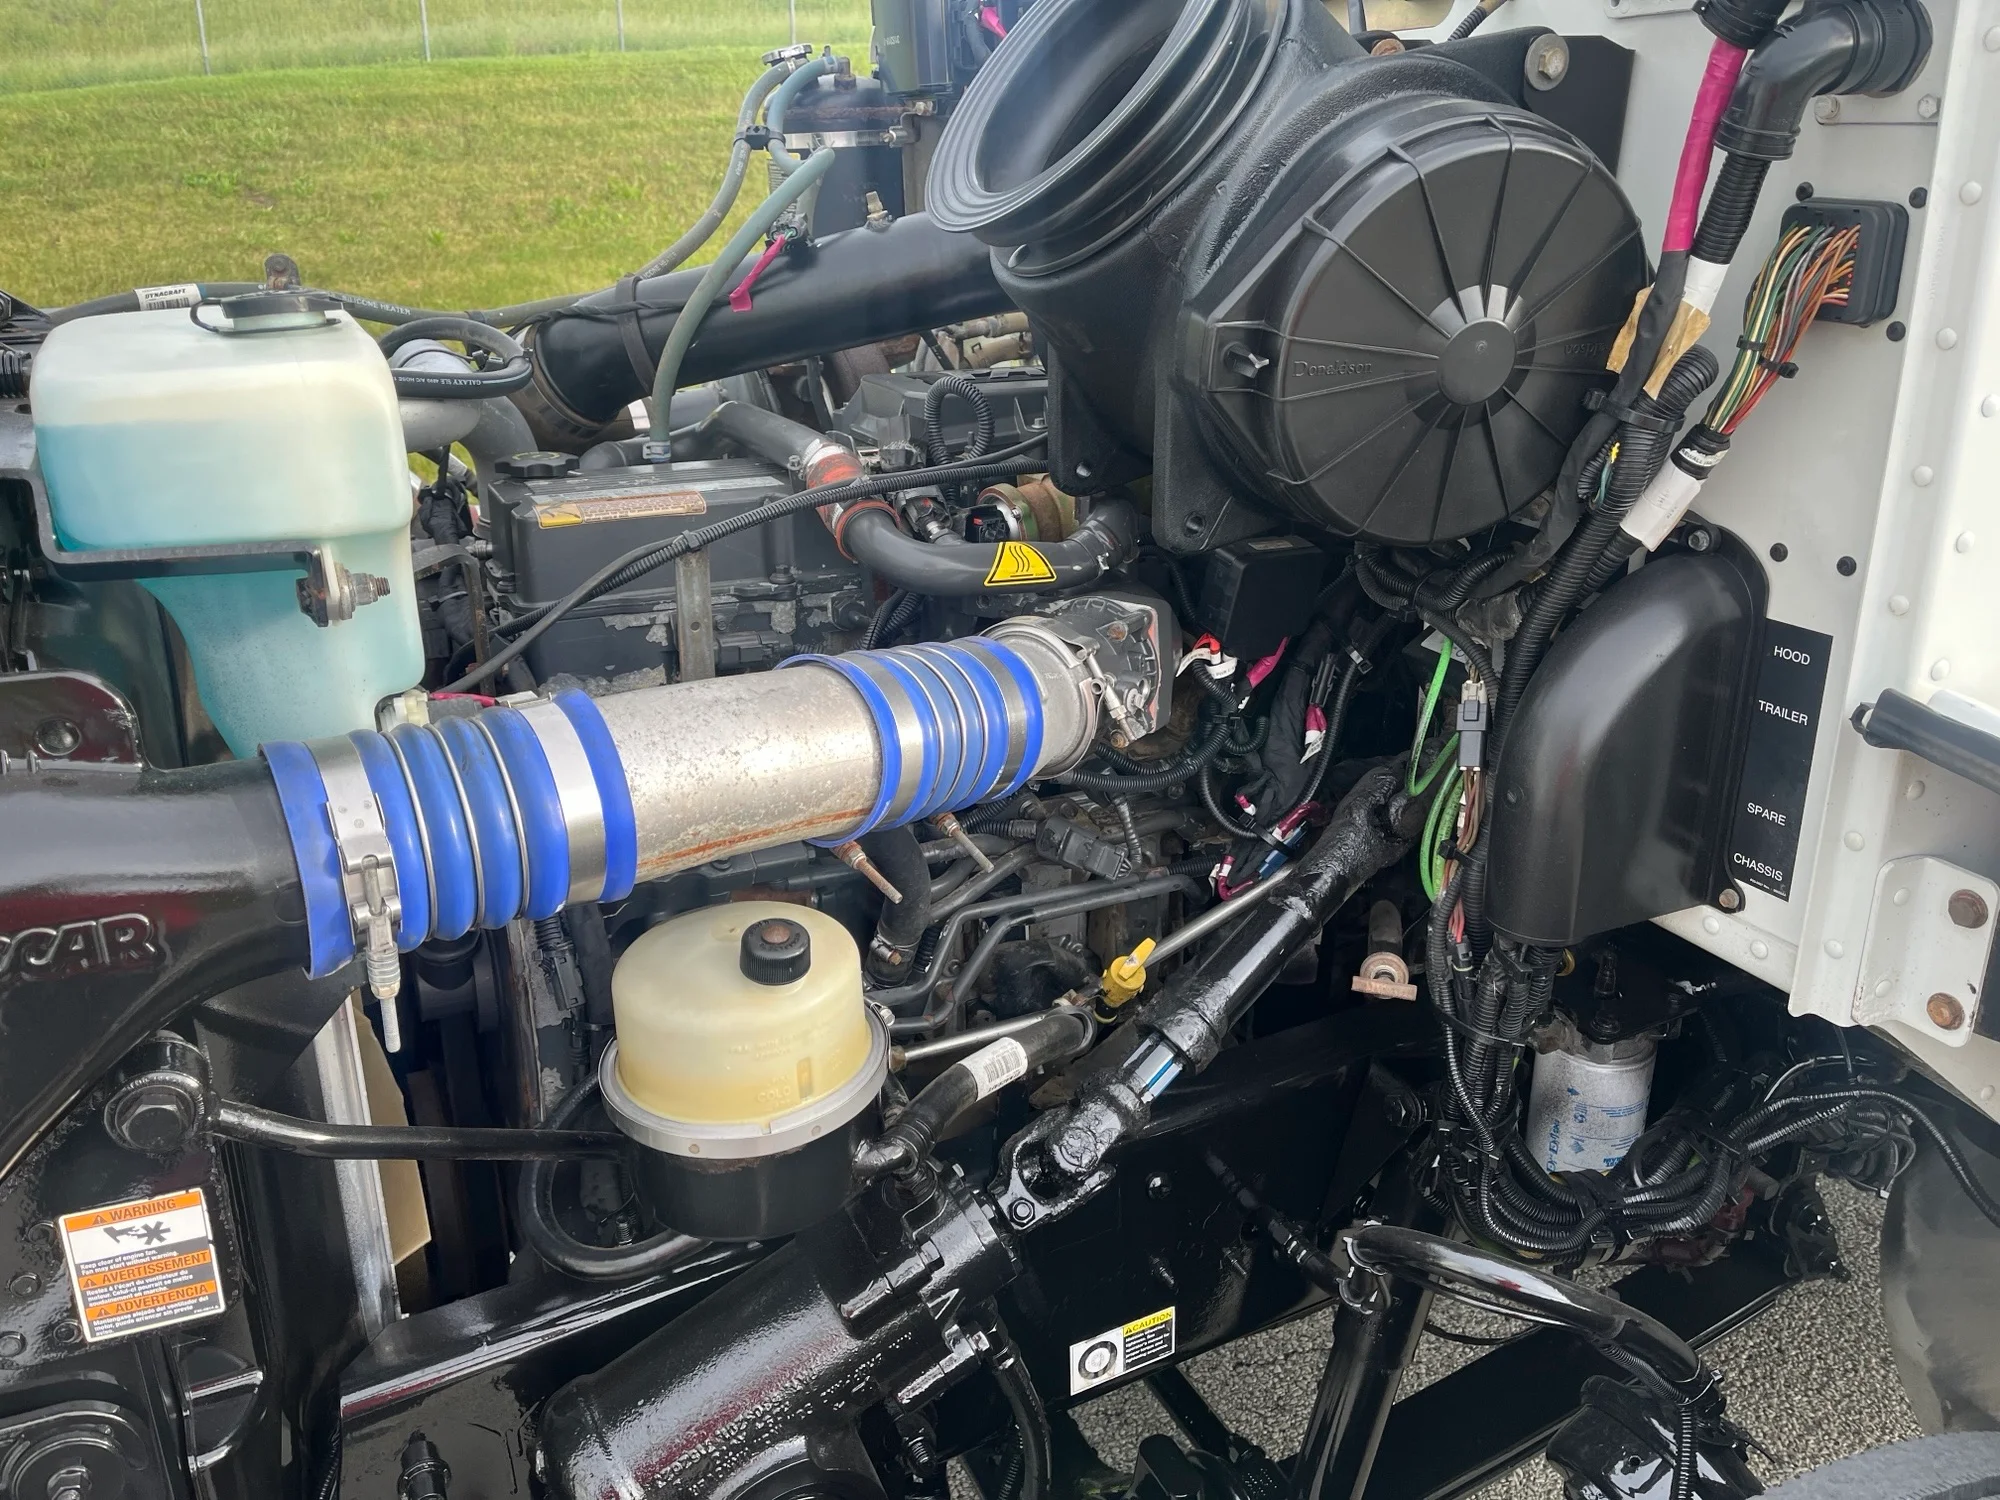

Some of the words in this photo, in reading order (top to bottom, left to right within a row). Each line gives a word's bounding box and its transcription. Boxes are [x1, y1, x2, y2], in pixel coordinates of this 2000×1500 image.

[144, 288, 186, 300] DYNACRAFT
[341, 295, 379, 309] SILICONE
[380, 303, 411, 316] HEATER
[1292, 360, 1373, 377] Donaldson
[1773, 645, 1811, 665] HOOD
[1758, 699, 1809, 726] TRAILER
[1746, 802, 1787, 826] SPARE
[1733, 852, 1783, 881] CHASSIS
[109, 1199, 176, 1222] WARNING
[80, 1262, 97, 1271] Keep
[97, 1258, 114, 1267] clear
[122, 1251, 145, 1262] engine
[145, 1248, 158, 1256] fan.
[81, 1269, 95, 1277] Fan
[94, 1265, 109, 1274] may
[109, 1262, 125, 1271] start
[125, 1256, 151, 1267] without
[151, 1249, 179, 1261] warning.
[101, 1251, 210, 1285] AVERTISSEMENT
[135, 1278, 145, 1286] du
[144, 1271, 179, 1284] ventilateur
[179, 1268, 188, 1276] du
[137, 1280, 163, 1292] pourrait
[163, 1278, 172, 1286] se
[171, 1273, 193, 1284] mettre
[114, 1283, 209, 1314] ADVERTENCIA
[132, 1307, 155, 1318] alejado
[155, 1305, 166, 1313] del
[166, 1297, 198, 1310] ventilador
[198, 1295, 209, 1303] del
[115, 1318, 135, 1328] puede
[163, 1309, 173, 1317] sin
[173, 1304, 194, 1314] previo
[1132, 1311, 1172, 1332] CAUTION
